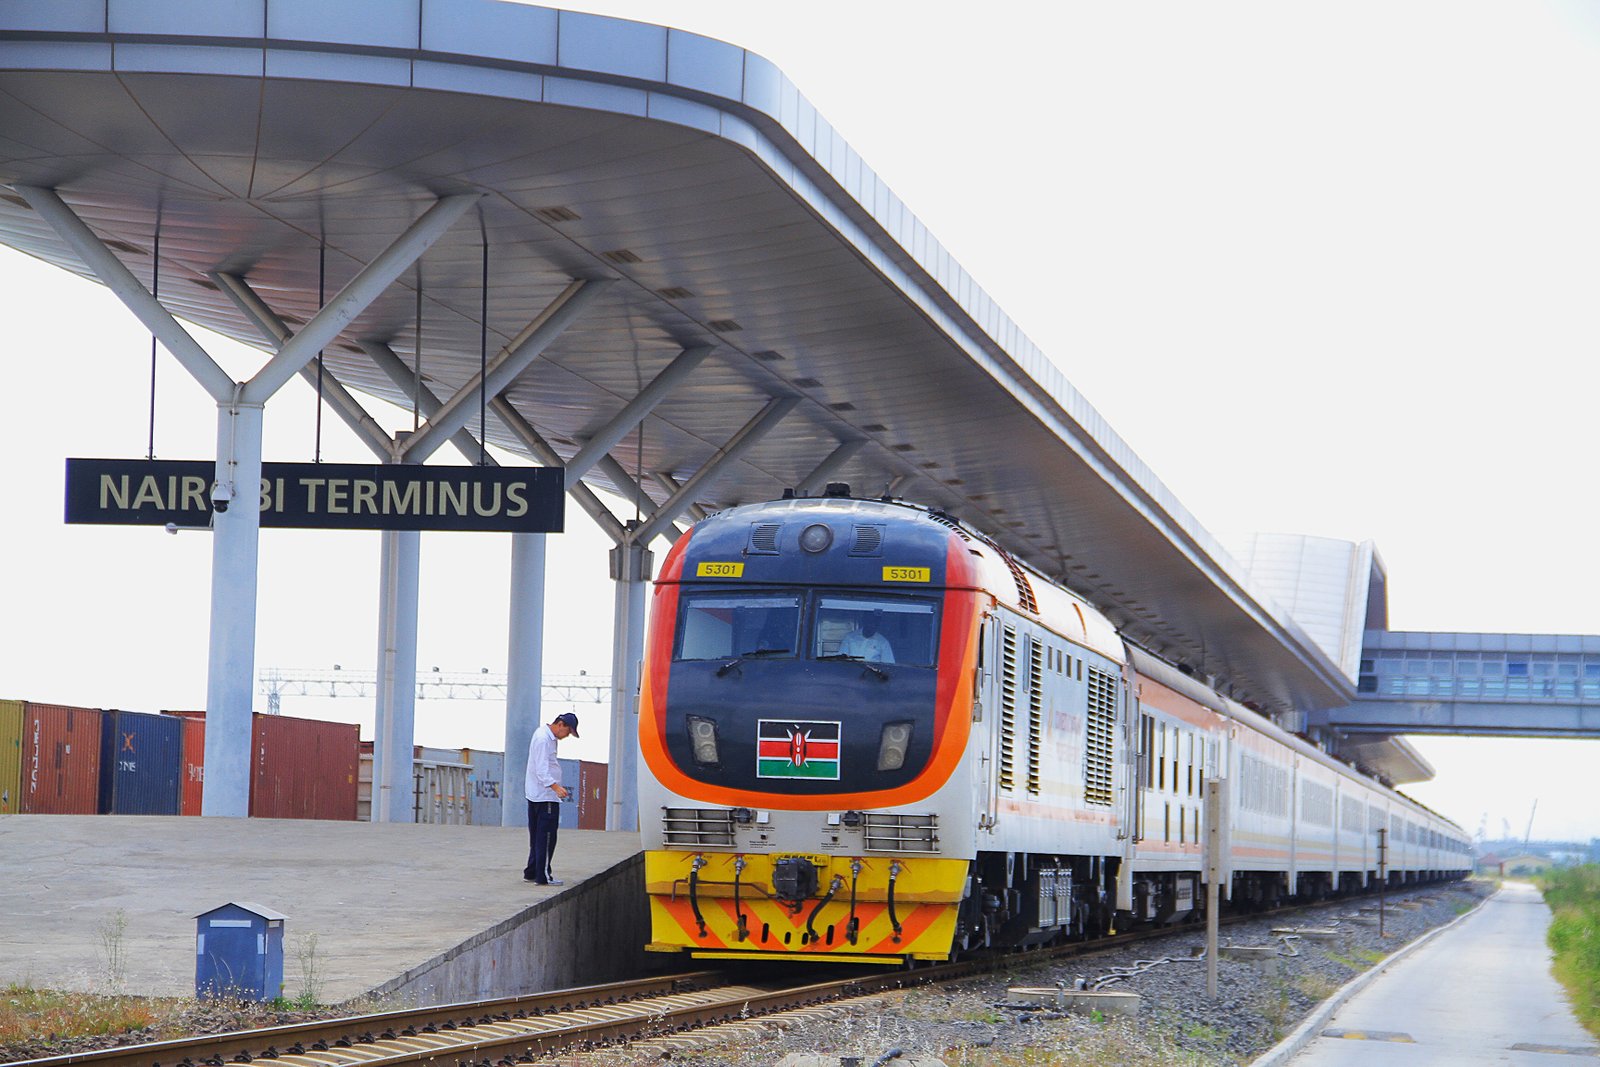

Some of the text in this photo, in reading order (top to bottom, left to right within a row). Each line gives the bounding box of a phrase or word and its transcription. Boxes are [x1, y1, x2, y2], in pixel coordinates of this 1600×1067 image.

[99, 474, 529, 518] NAIRBI TERMINUS
[705, 564, 736, 575] 5301
[890, 568, 923, 580] 5301
